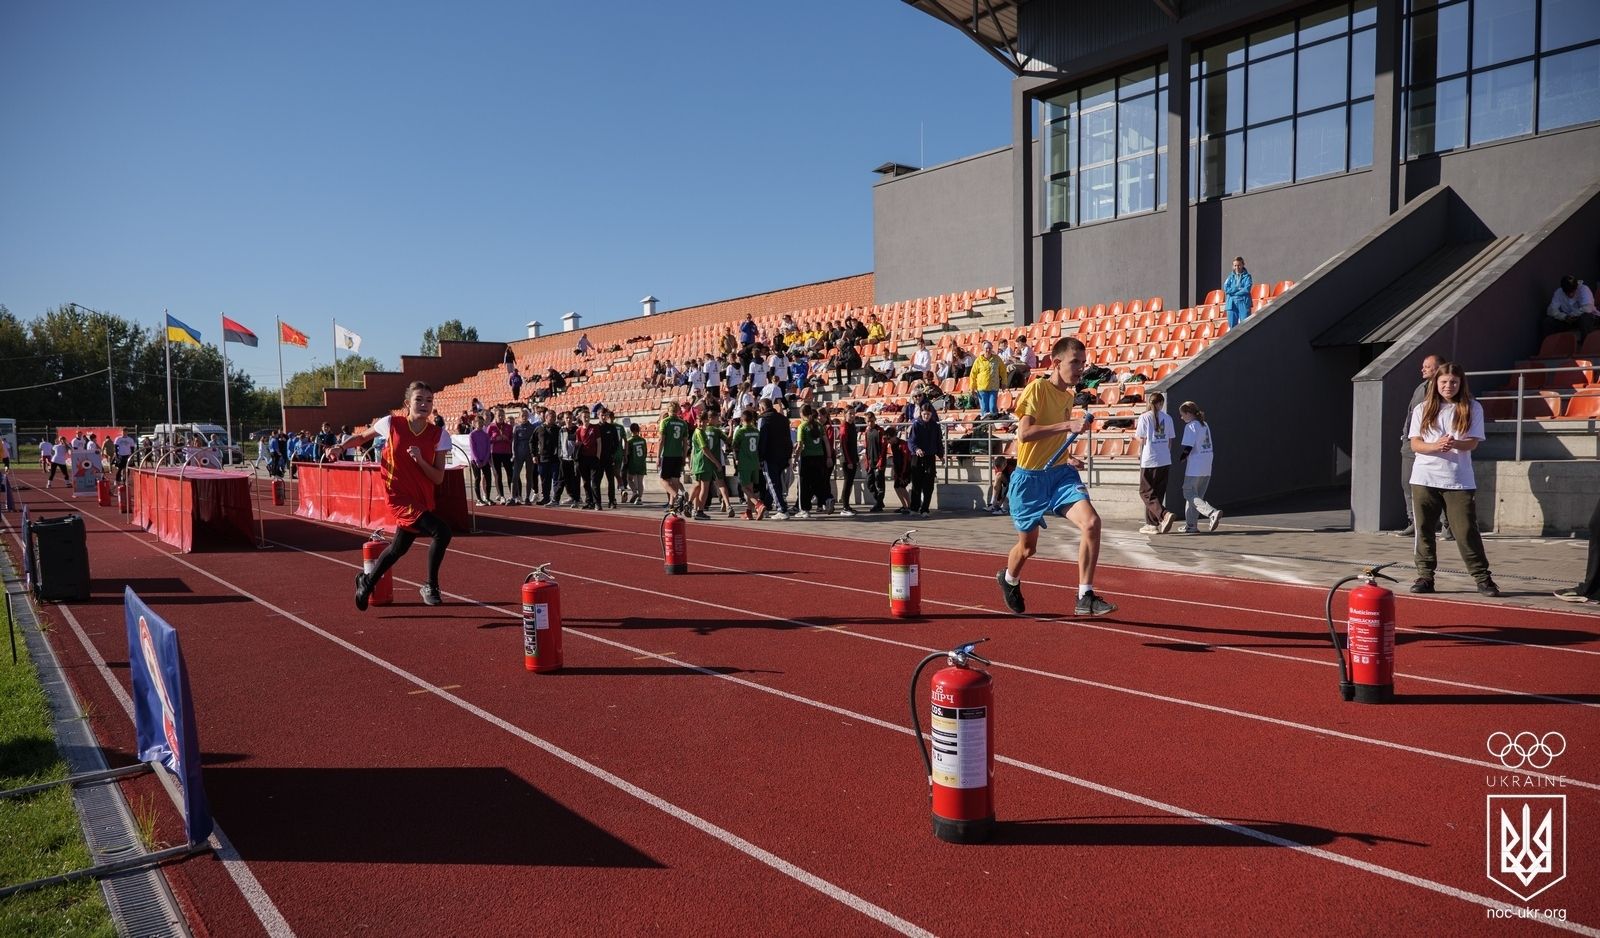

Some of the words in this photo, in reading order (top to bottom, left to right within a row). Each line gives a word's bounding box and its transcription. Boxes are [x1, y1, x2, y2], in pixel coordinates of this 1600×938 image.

[673, 425, 681, 439] 3
[636, 445, 644, 457] 5
[749, 437, 757, 452] 8
[935, 684, 944, 694] 25
